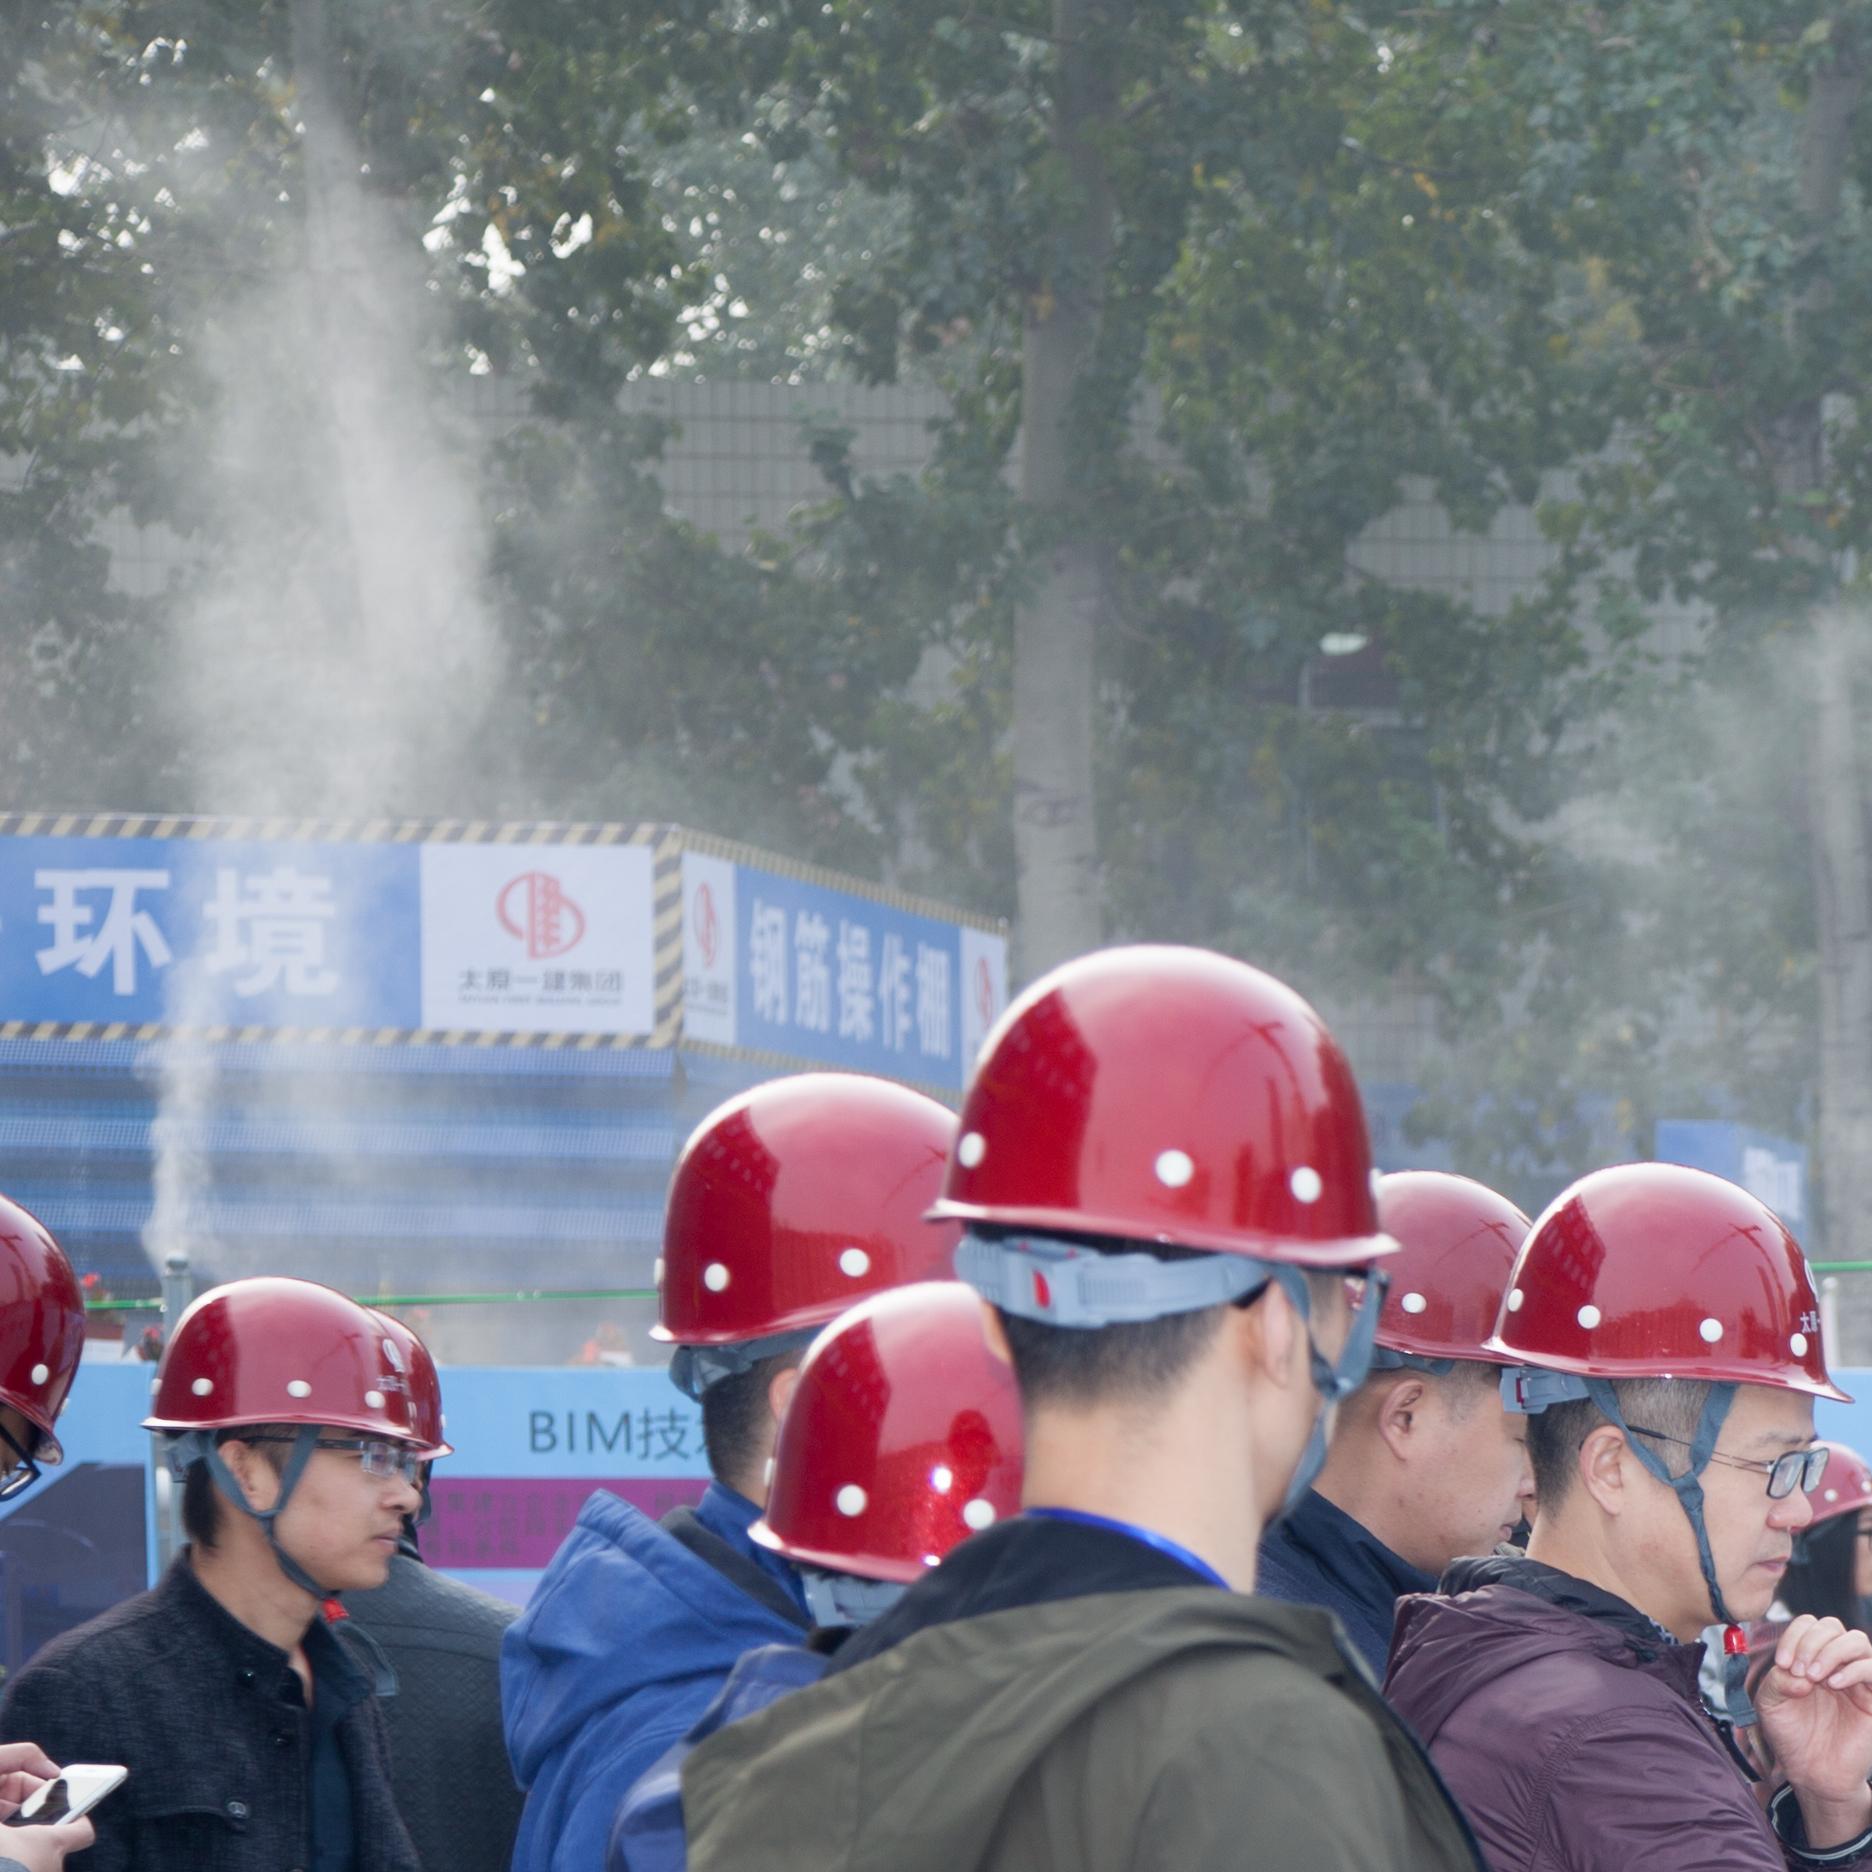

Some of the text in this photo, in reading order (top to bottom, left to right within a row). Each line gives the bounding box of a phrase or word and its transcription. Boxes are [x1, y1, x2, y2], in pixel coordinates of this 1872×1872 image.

[34, 866, 340, 997] 环境
[749, 899, 952, 1060] 钢筋操作棚
[528, 1407, 708, 1462] BIM技
